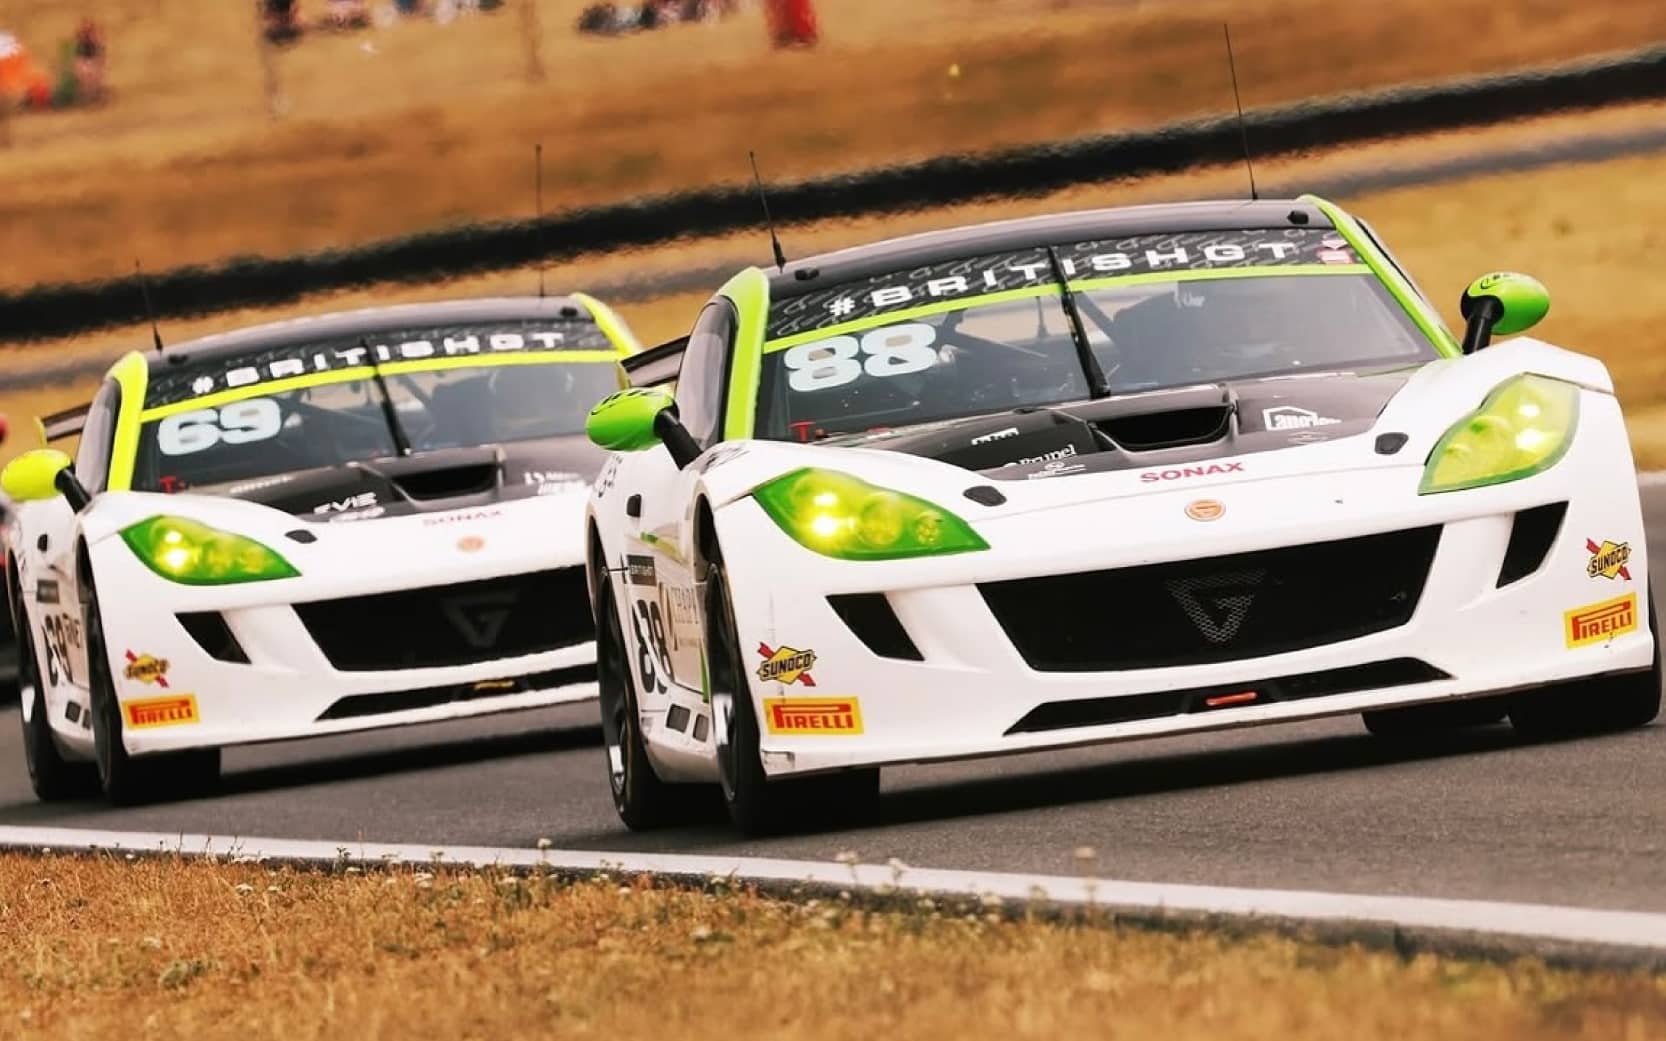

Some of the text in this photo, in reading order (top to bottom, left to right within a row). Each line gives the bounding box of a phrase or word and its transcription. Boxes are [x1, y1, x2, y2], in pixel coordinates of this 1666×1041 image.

[828, 242, 1295, 317] #BRITISHGT
[784, 323, 938, 392] 88
[157, 398, 282, 456] 69
[1140, 462, 1244, 483] SONAX
[1591, 546, 1629, 575] SUNOCO
[1571, 600, 1633, 641] PIRELLI
[762, 653, 812, 678] SUNOCO
[128, 699, 193, 725] PIRELLI
[772, 703, 855, 729] PIRELLI
